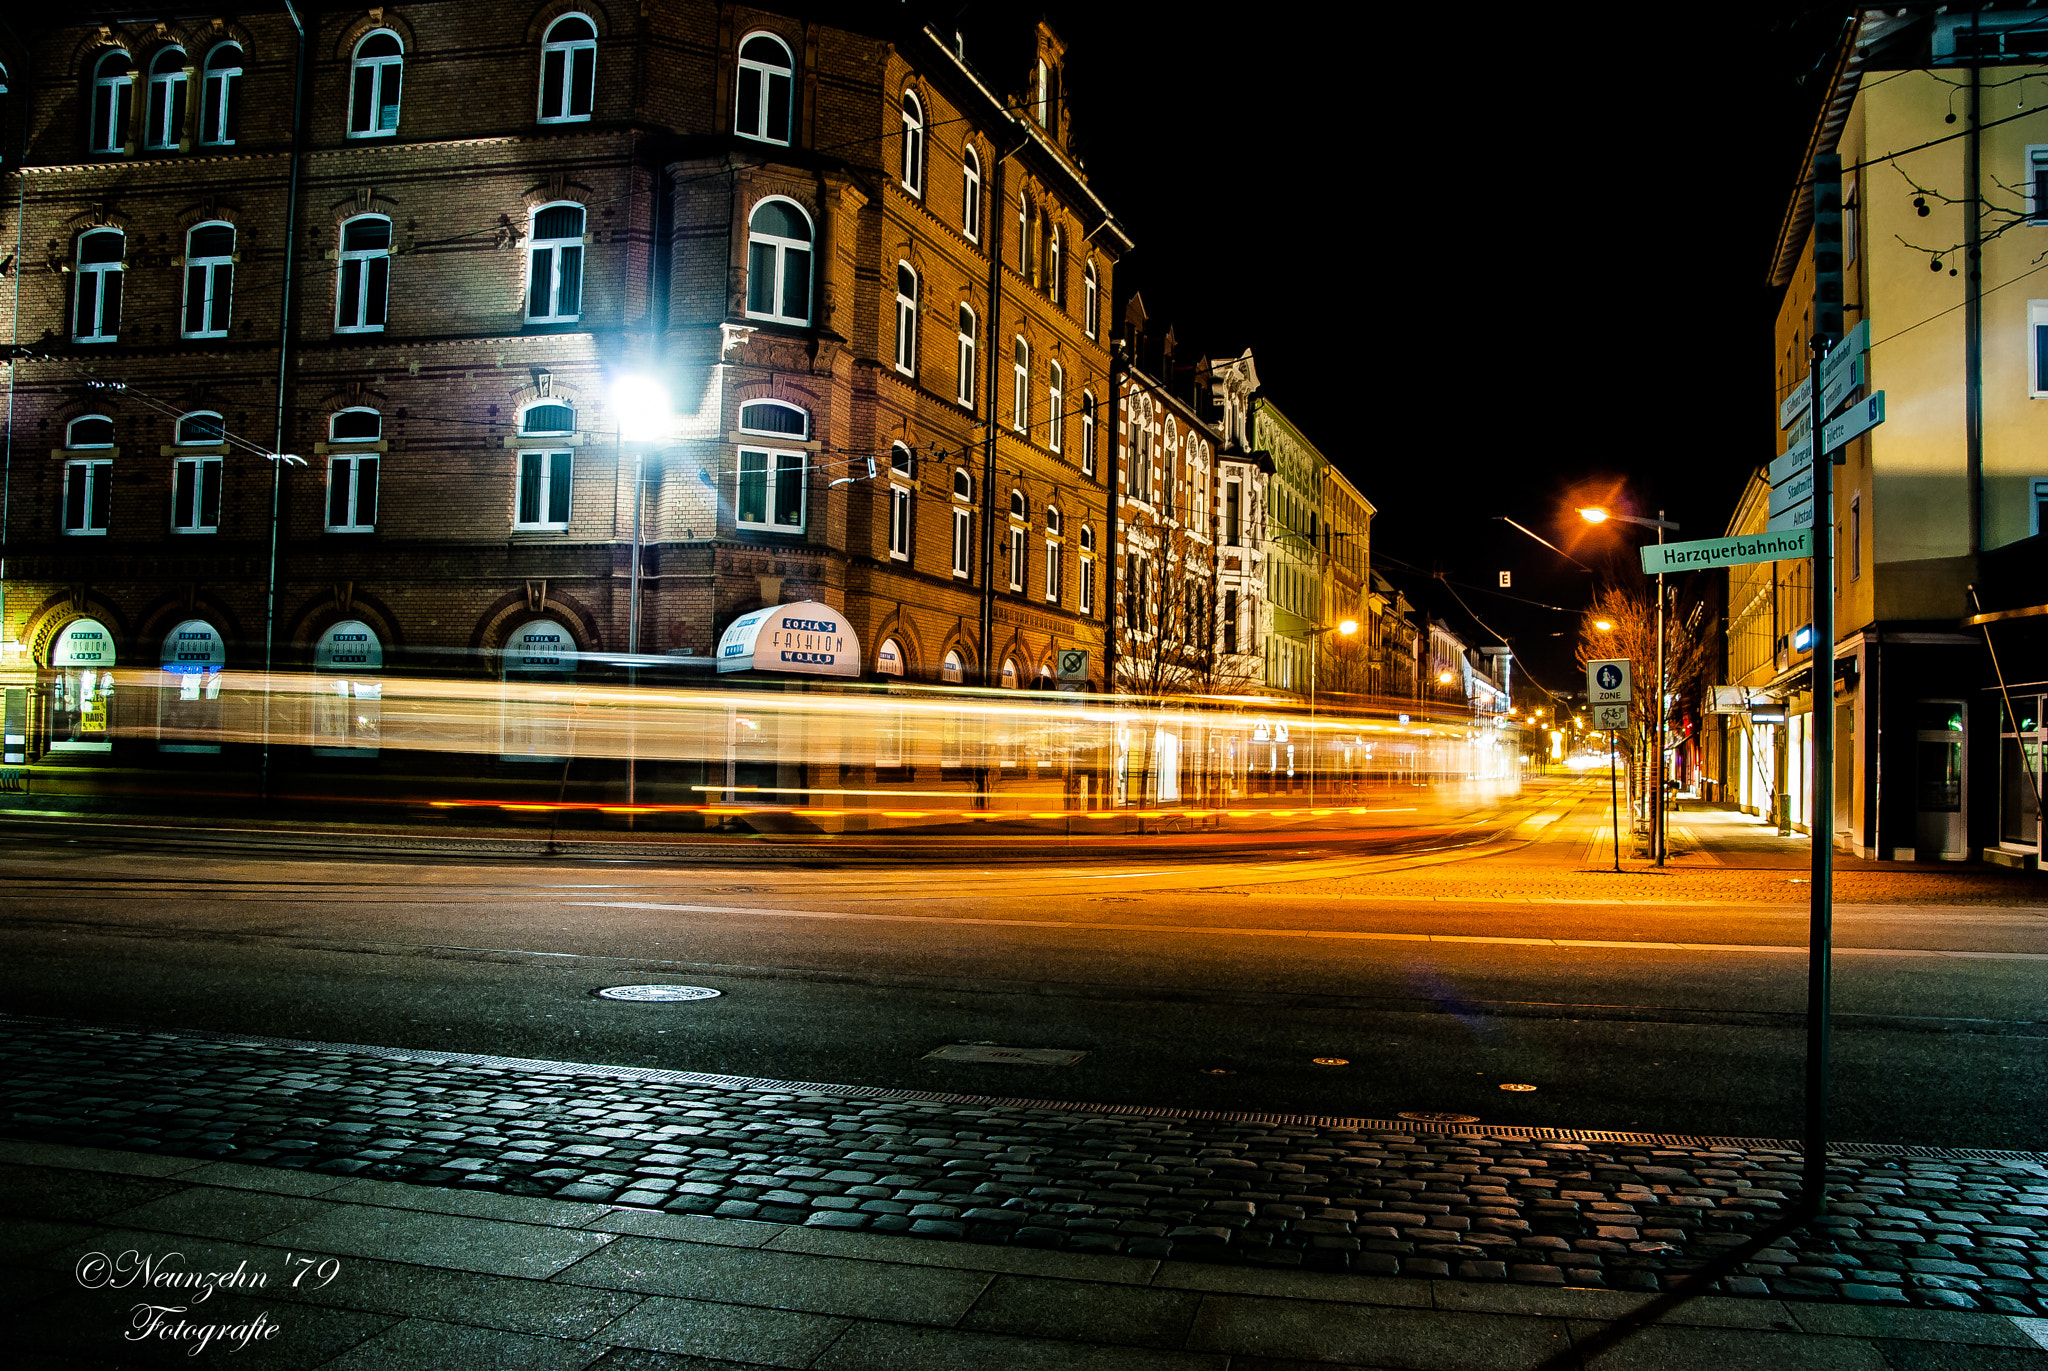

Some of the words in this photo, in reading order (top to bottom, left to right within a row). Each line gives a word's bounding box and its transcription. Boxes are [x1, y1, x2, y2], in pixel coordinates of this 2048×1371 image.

[1825, 423, 1845, 446] oilette
[1792, 446, 1812, 468] Zorgeau
[1788, 474, 1812, 500] Stadtmitt
[1793, 505, 1812, 527] Altstad
[1664, 534, 1806, 564] Harzquerbahnhof
[785, 620, 833, 632] SOFIA'S
[773, 632, 843, 652] FASHION
[784, 653, 831, 663] WORLD
[86, 712, 104, 722] RAUS
